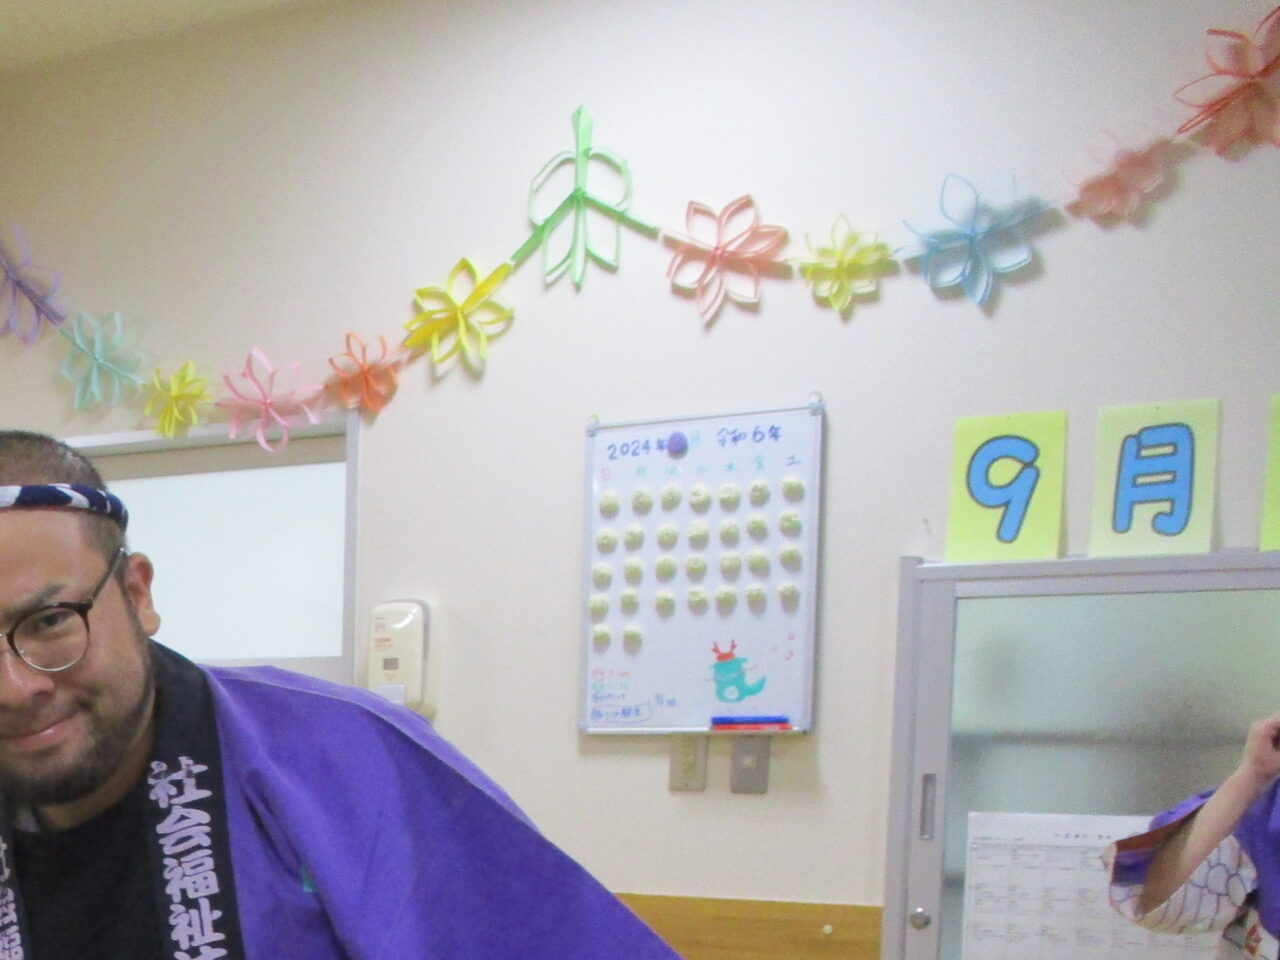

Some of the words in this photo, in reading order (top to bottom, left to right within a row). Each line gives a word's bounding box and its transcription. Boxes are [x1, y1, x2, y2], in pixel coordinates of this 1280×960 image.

[717, 424, 783, 447] 令和6年
[966, 422, 1195, 544] 9月
